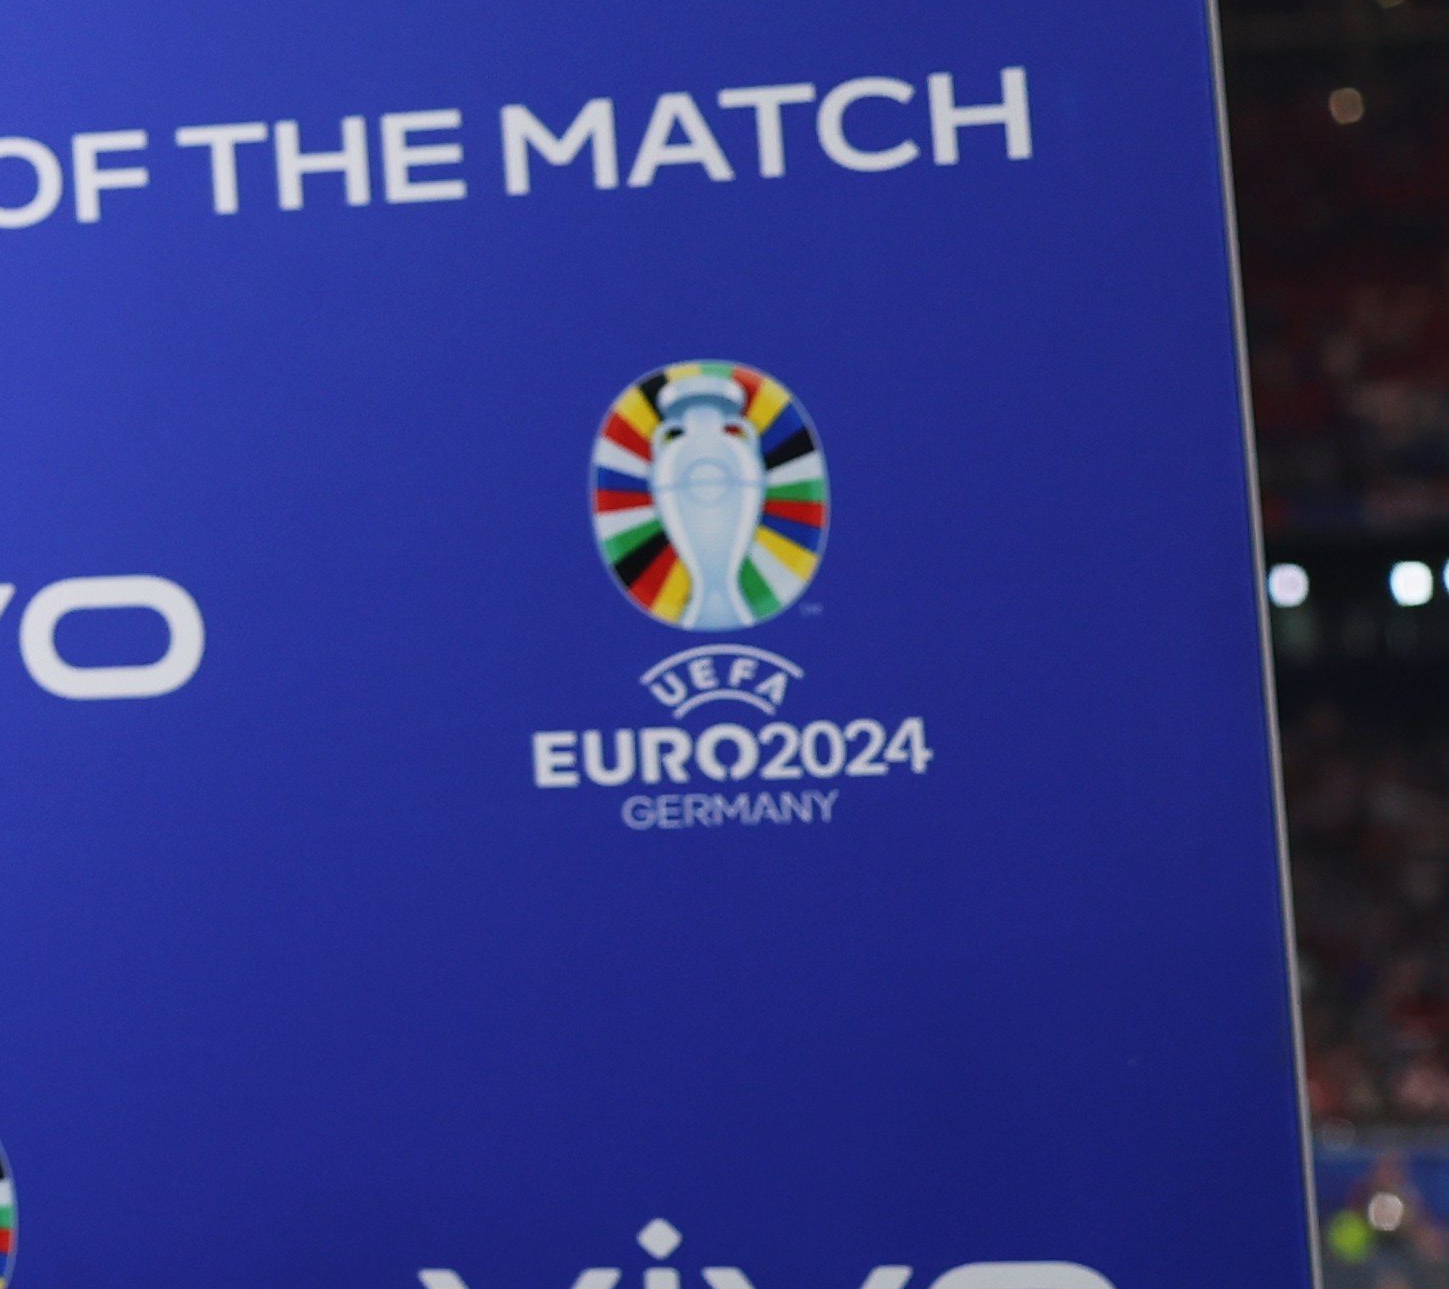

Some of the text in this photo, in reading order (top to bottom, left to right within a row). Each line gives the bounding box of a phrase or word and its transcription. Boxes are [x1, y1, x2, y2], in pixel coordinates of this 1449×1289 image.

[174, 108, 468, 215] THE
[500, 67, 1033, 196] MATCH
[650, 657, 789, 706] UEFA
[621, 789, 839, 830] GERMANY
